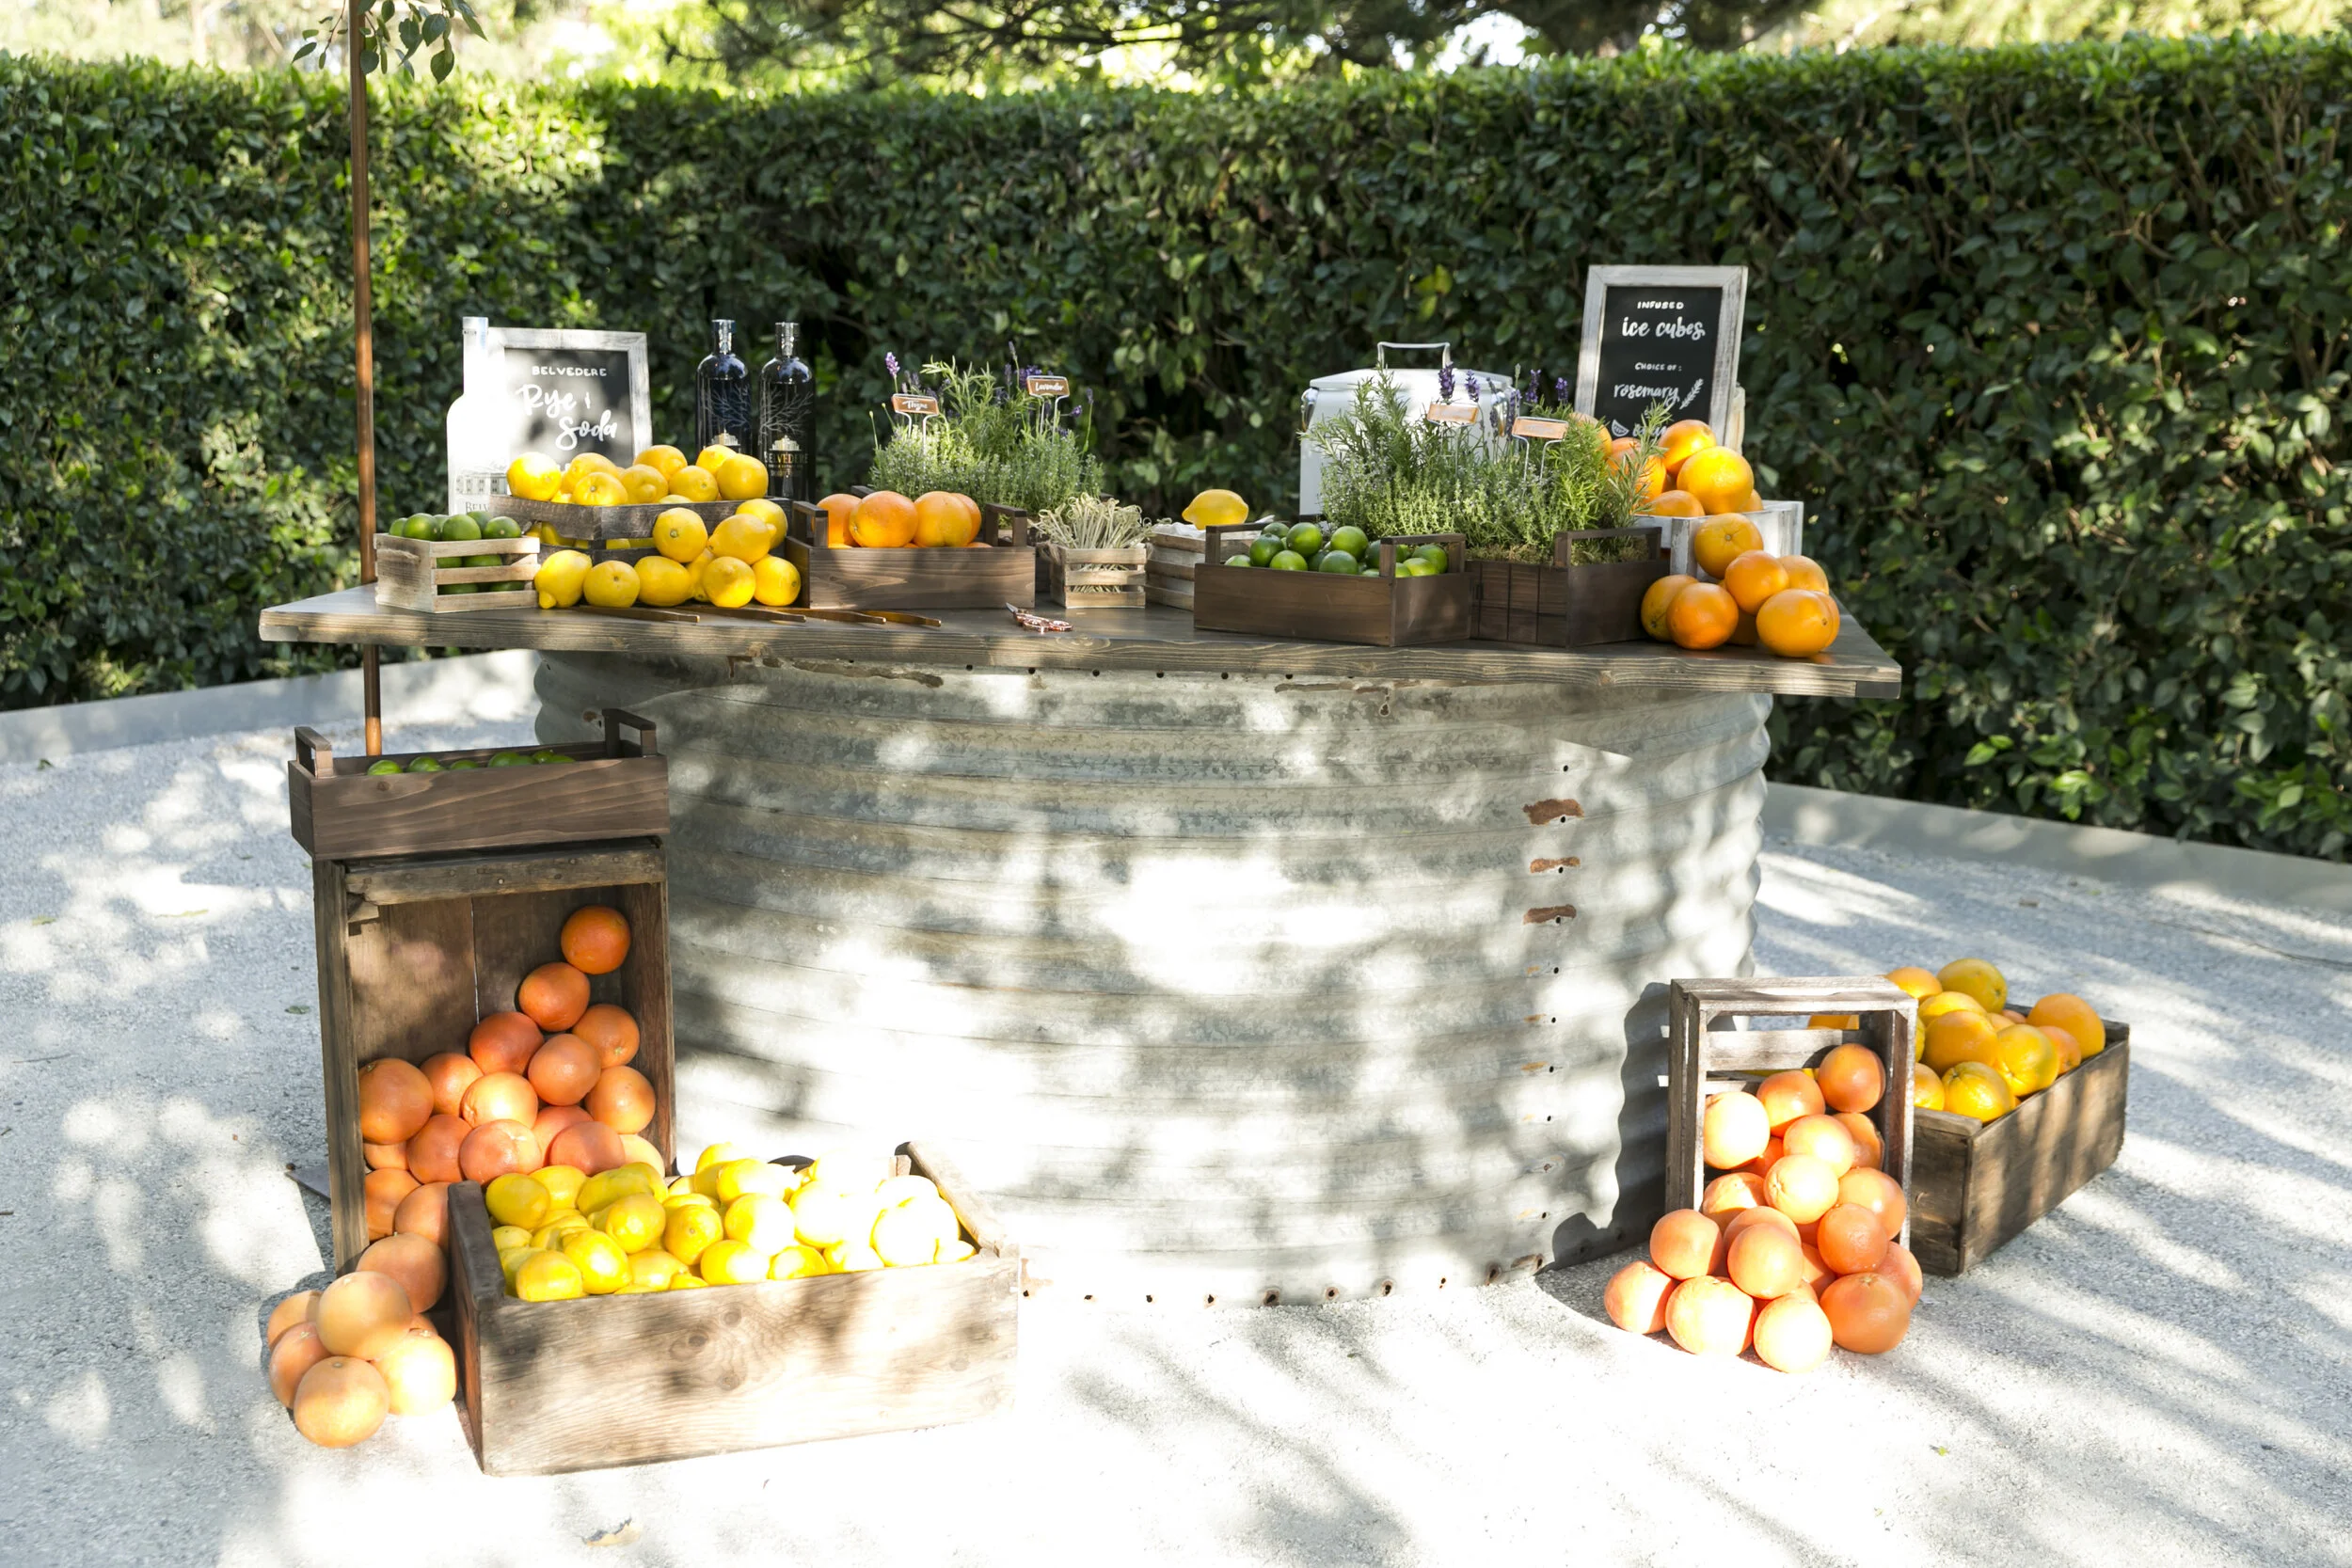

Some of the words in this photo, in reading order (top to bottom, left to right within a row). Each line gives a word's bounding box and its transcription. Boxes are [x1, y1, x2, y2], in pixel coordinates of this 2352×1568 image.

[1637, 300, 1684, 310] INFUSED
[1622, 316, 1650, 337] ice
[1655, 316, 1706, 341] cubes
[532, 366, 607, 376] BELVEDERE
[1634, 362, 1665, 372] CHOICE
[516, 383, 577, 419] Rye
[1613, 383, 1680, 407] rosemary
[555, 409, 618, 451] Soda
